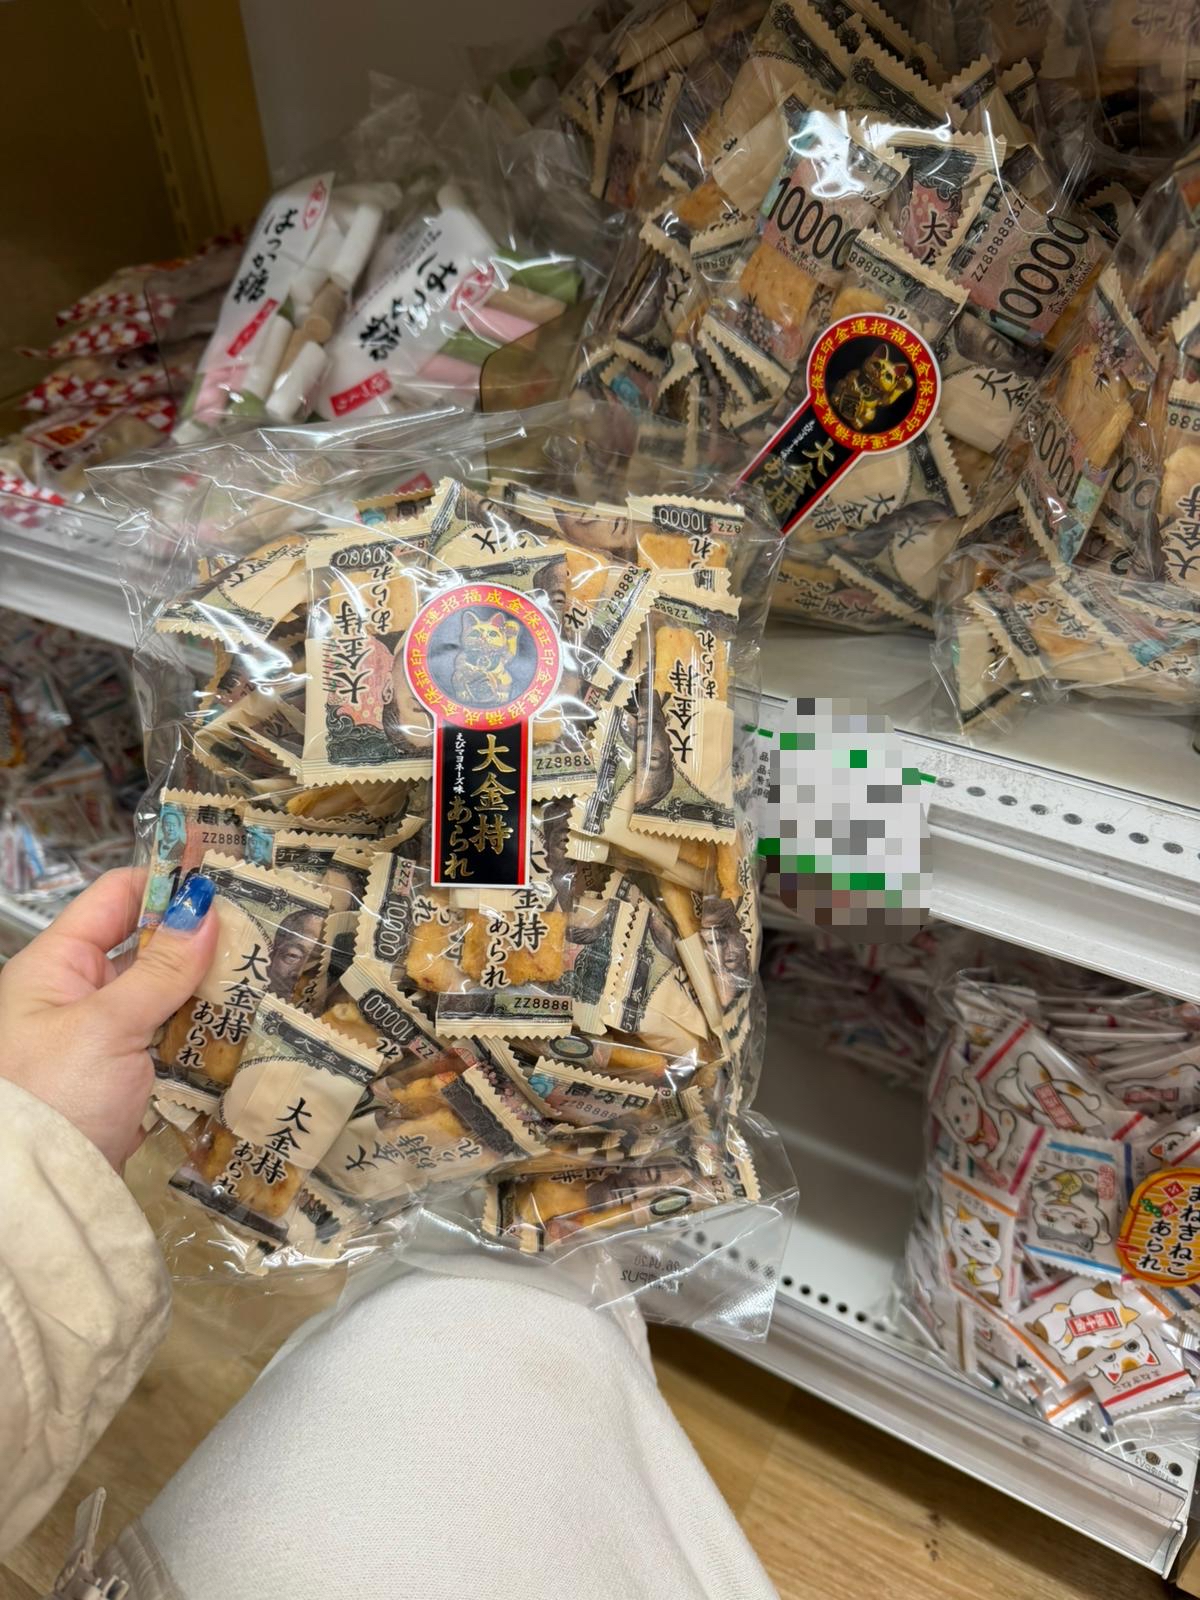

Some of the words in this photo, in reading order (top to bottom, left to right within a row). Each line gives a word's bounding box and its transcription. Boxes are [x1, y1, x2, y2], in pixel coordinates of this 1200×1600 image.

[989, 216, 1090, 330] 10000
[659, 508, 708, 532] 10000
[372, 565, 394, 632] あられ
[332, 600, 372, 704] 大金持
[697, 632, 717, 699] あられ
[668, 659, 700, 764] 大金持
[453, 732, 467, 795] えびマヨネーズ味
[470, 733, 517, 855] 大金持
[444, 795, 475, 880] あられ
[483, 913, 510, 988] あられ
[213, 943, 270, 1043] 大金持
[364, 993, 415, 1043] 10000
[513, 996, 573, 1012] ZZ8888
[179, 1001, 215, 1068] あられ
[250, 1096, 314, 1184] 大金持
[1138, 1219, 1173, 1271] あられ
